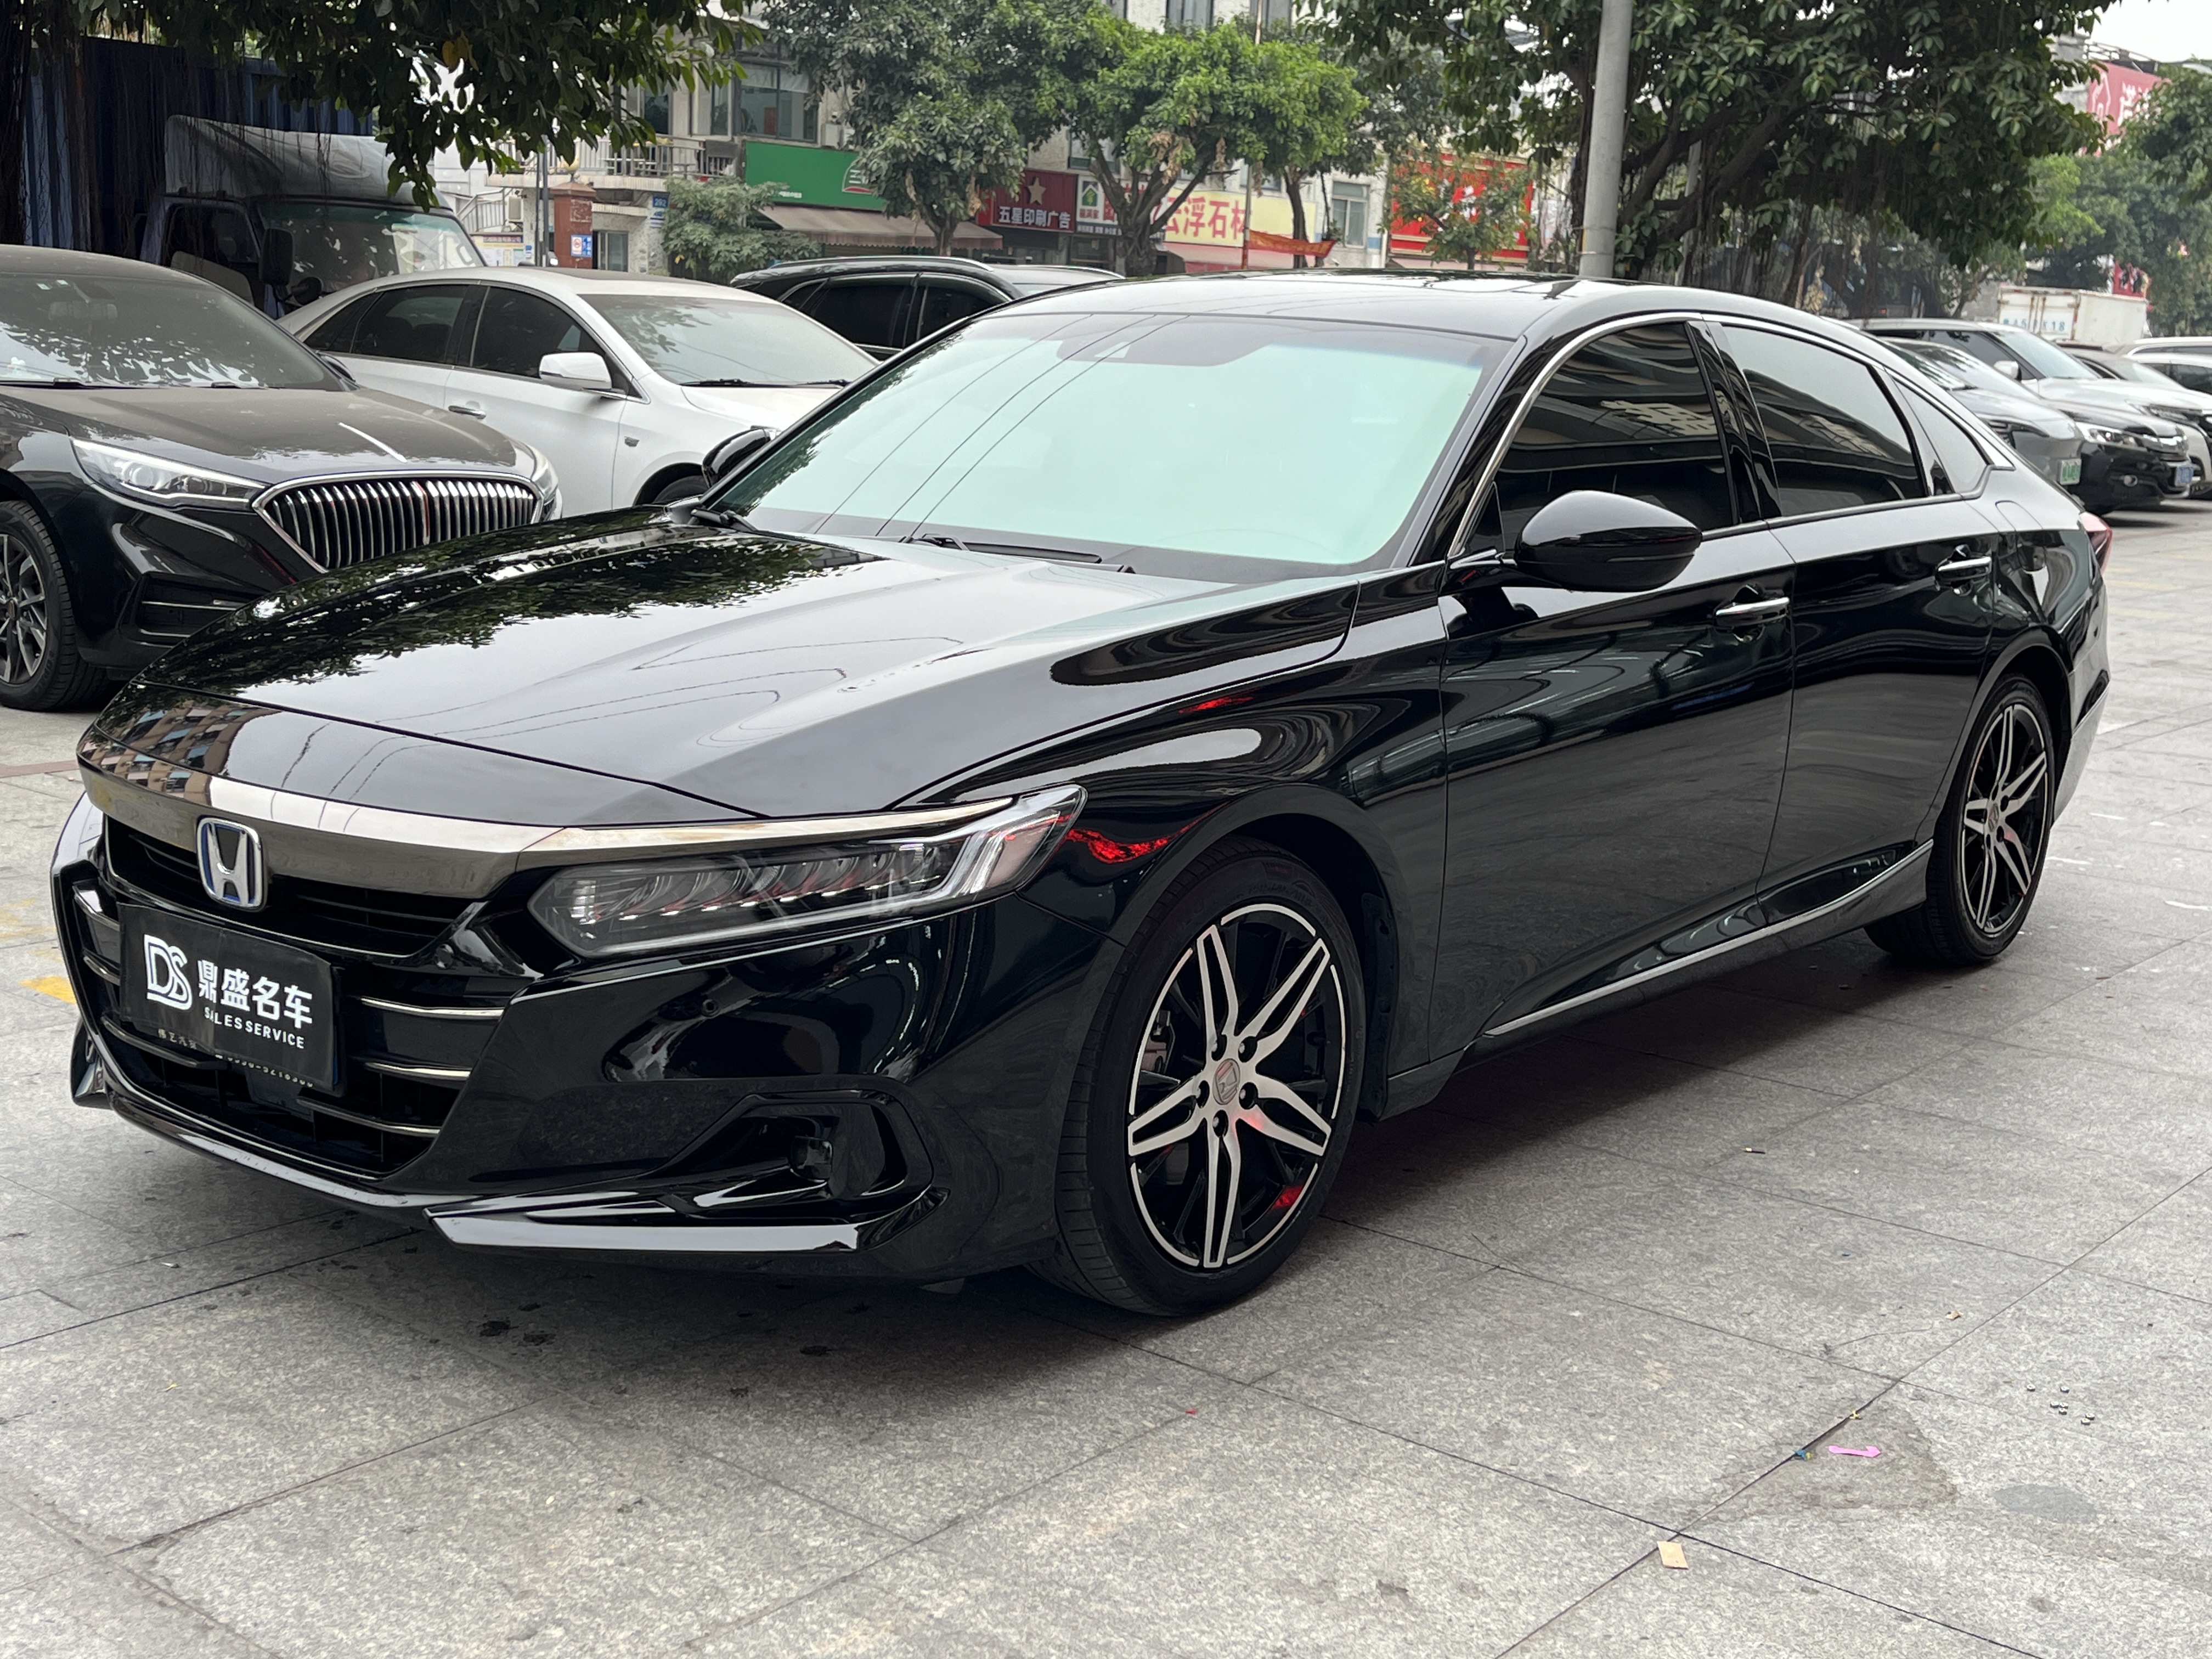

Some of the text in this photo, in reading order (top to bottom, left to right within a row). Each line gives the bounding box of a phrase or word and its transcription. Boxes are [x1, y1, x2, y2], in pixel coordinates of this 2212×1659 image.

[998, 206, 1070, 229] 五星印刷广告
[144, 934, 193, 1010] DS
[198, 959, 313, 1029] 鼎盛名车
